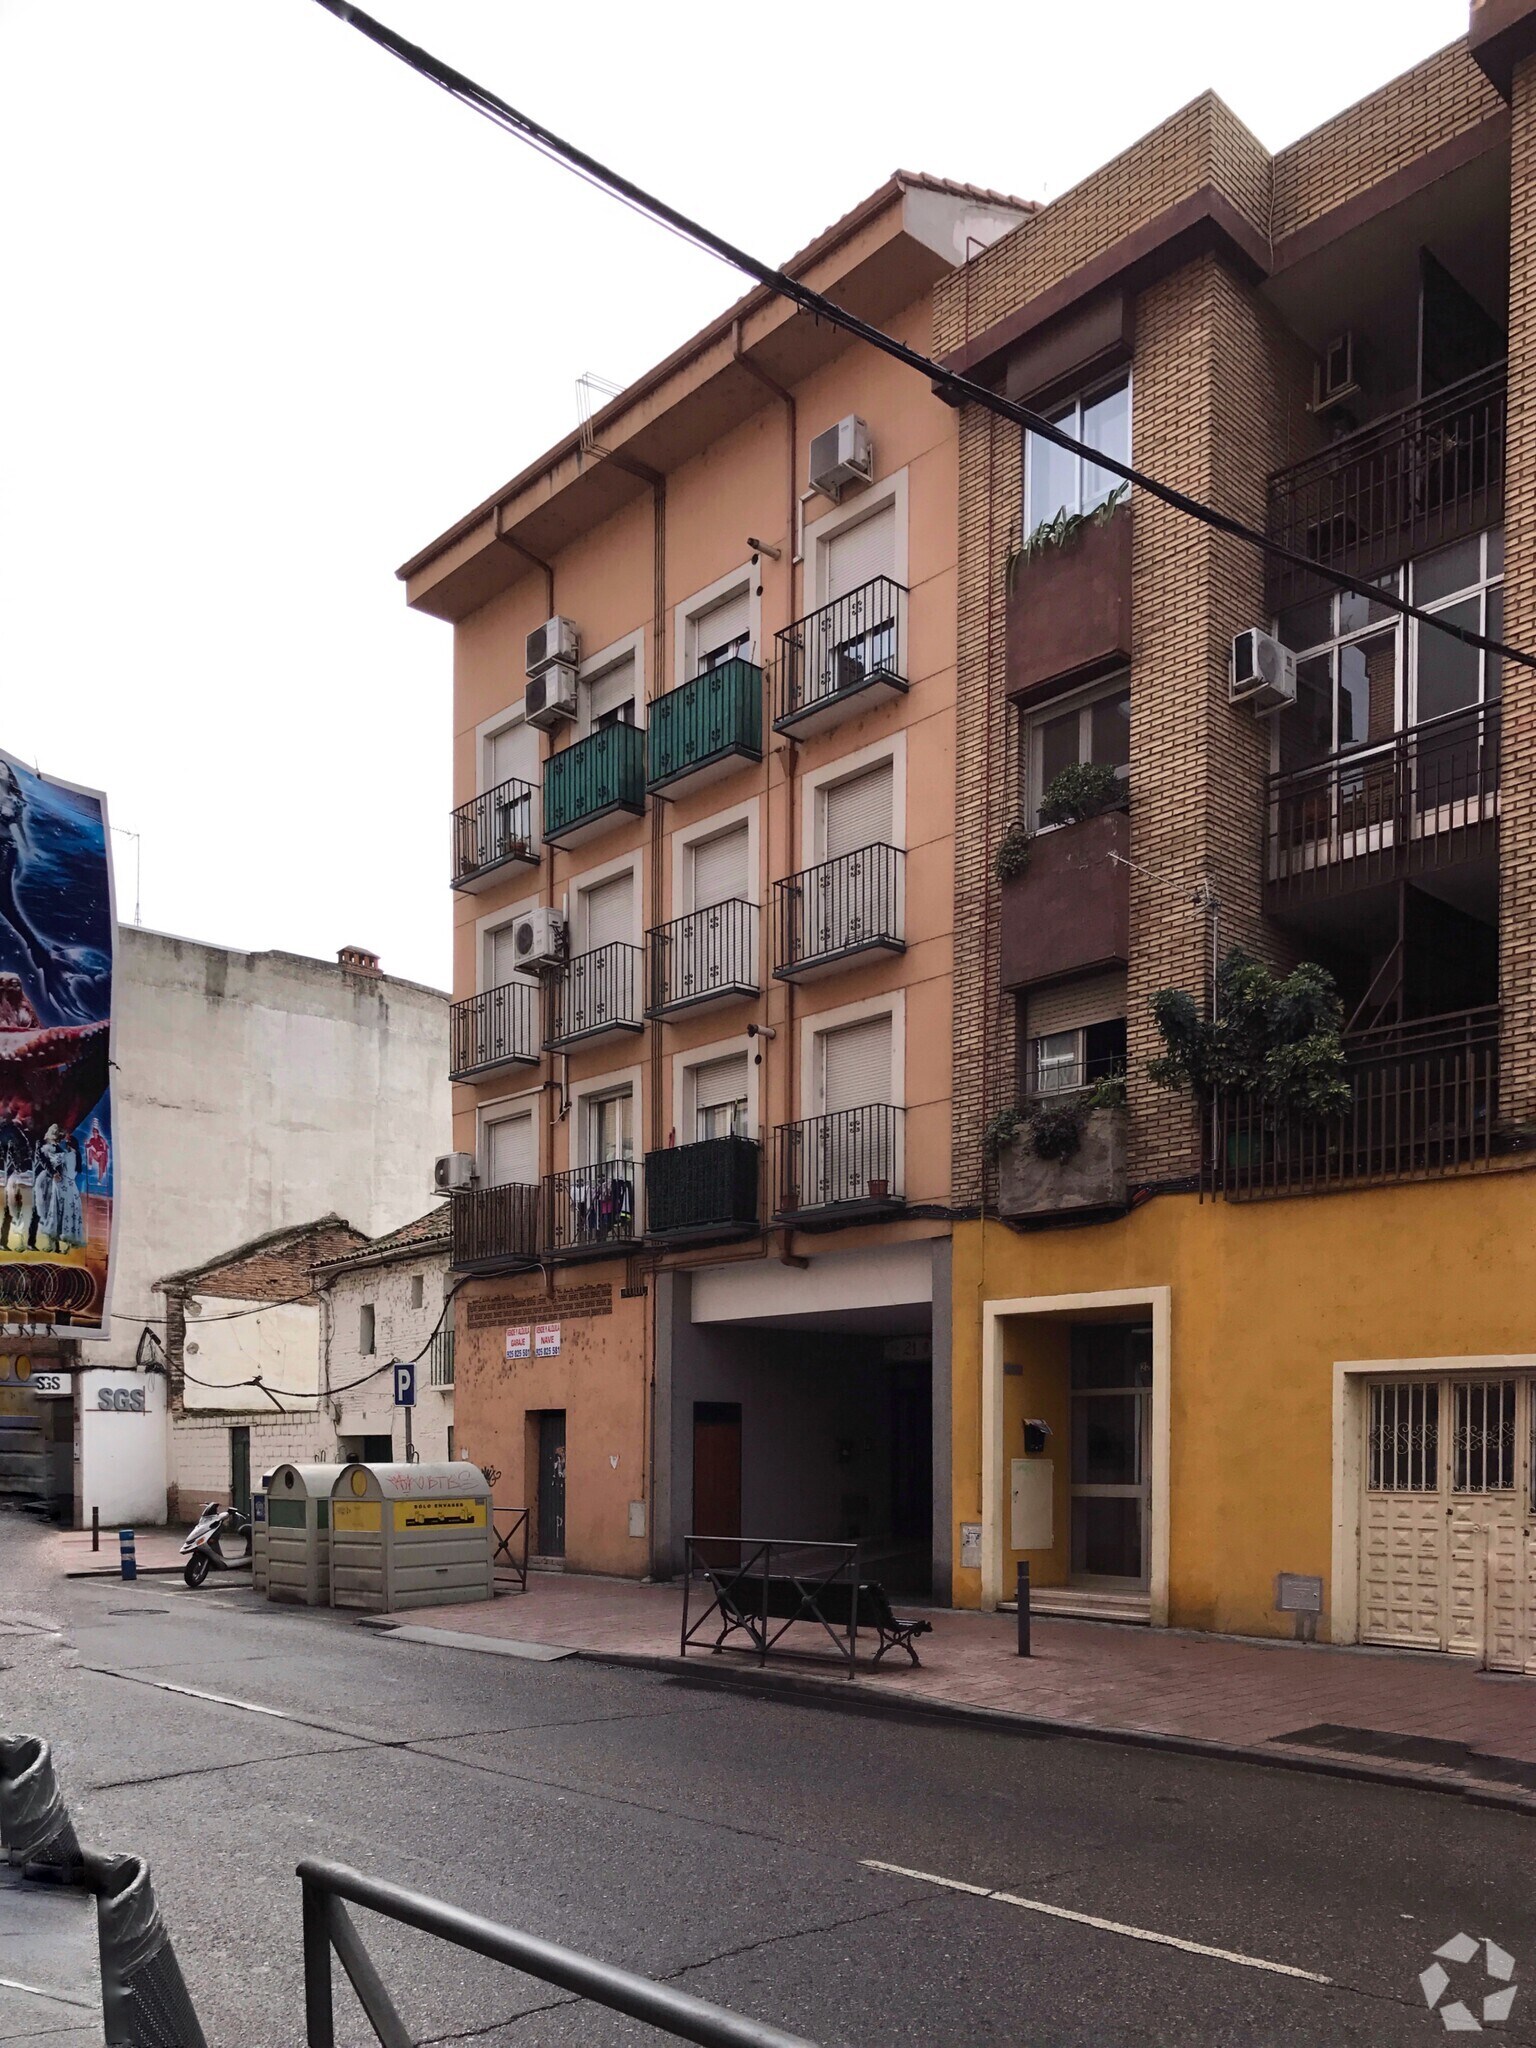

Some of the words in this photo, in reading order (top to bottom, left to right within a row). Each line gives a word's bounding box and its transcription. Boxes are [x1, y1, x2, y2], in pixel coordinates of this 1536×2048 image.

[511, 1338, 526, 1346] GARAJE
[541, 1336, 554, 1344] NAVE
[37, 1376, 60, 1390] SGS
[398, 1369, 411, 1401] P
[98, 1387, 145, 1412] SGS
